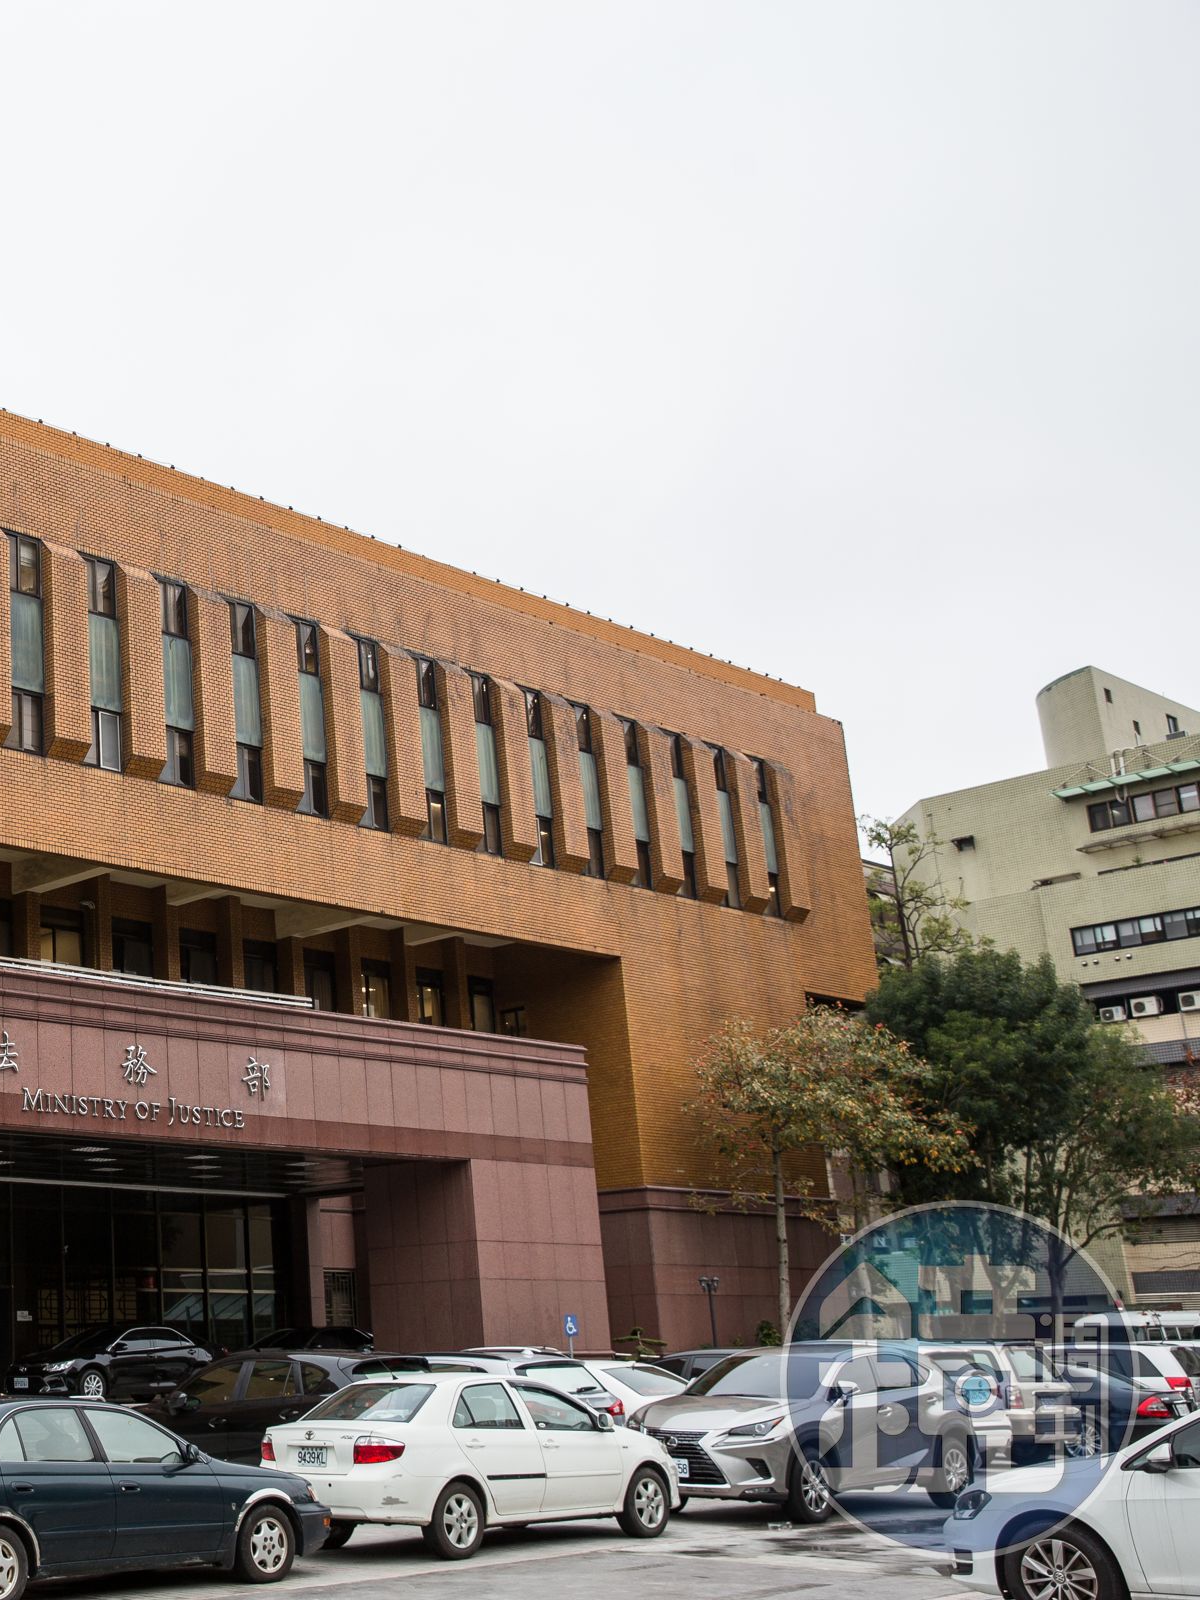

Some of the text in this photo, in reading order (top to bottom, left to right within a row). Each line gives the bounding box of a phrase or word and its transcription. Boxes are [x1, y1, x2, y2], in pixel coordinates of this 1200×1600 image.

[21, 1087, 246, 1129] MINISTRY OF JUSTICE
